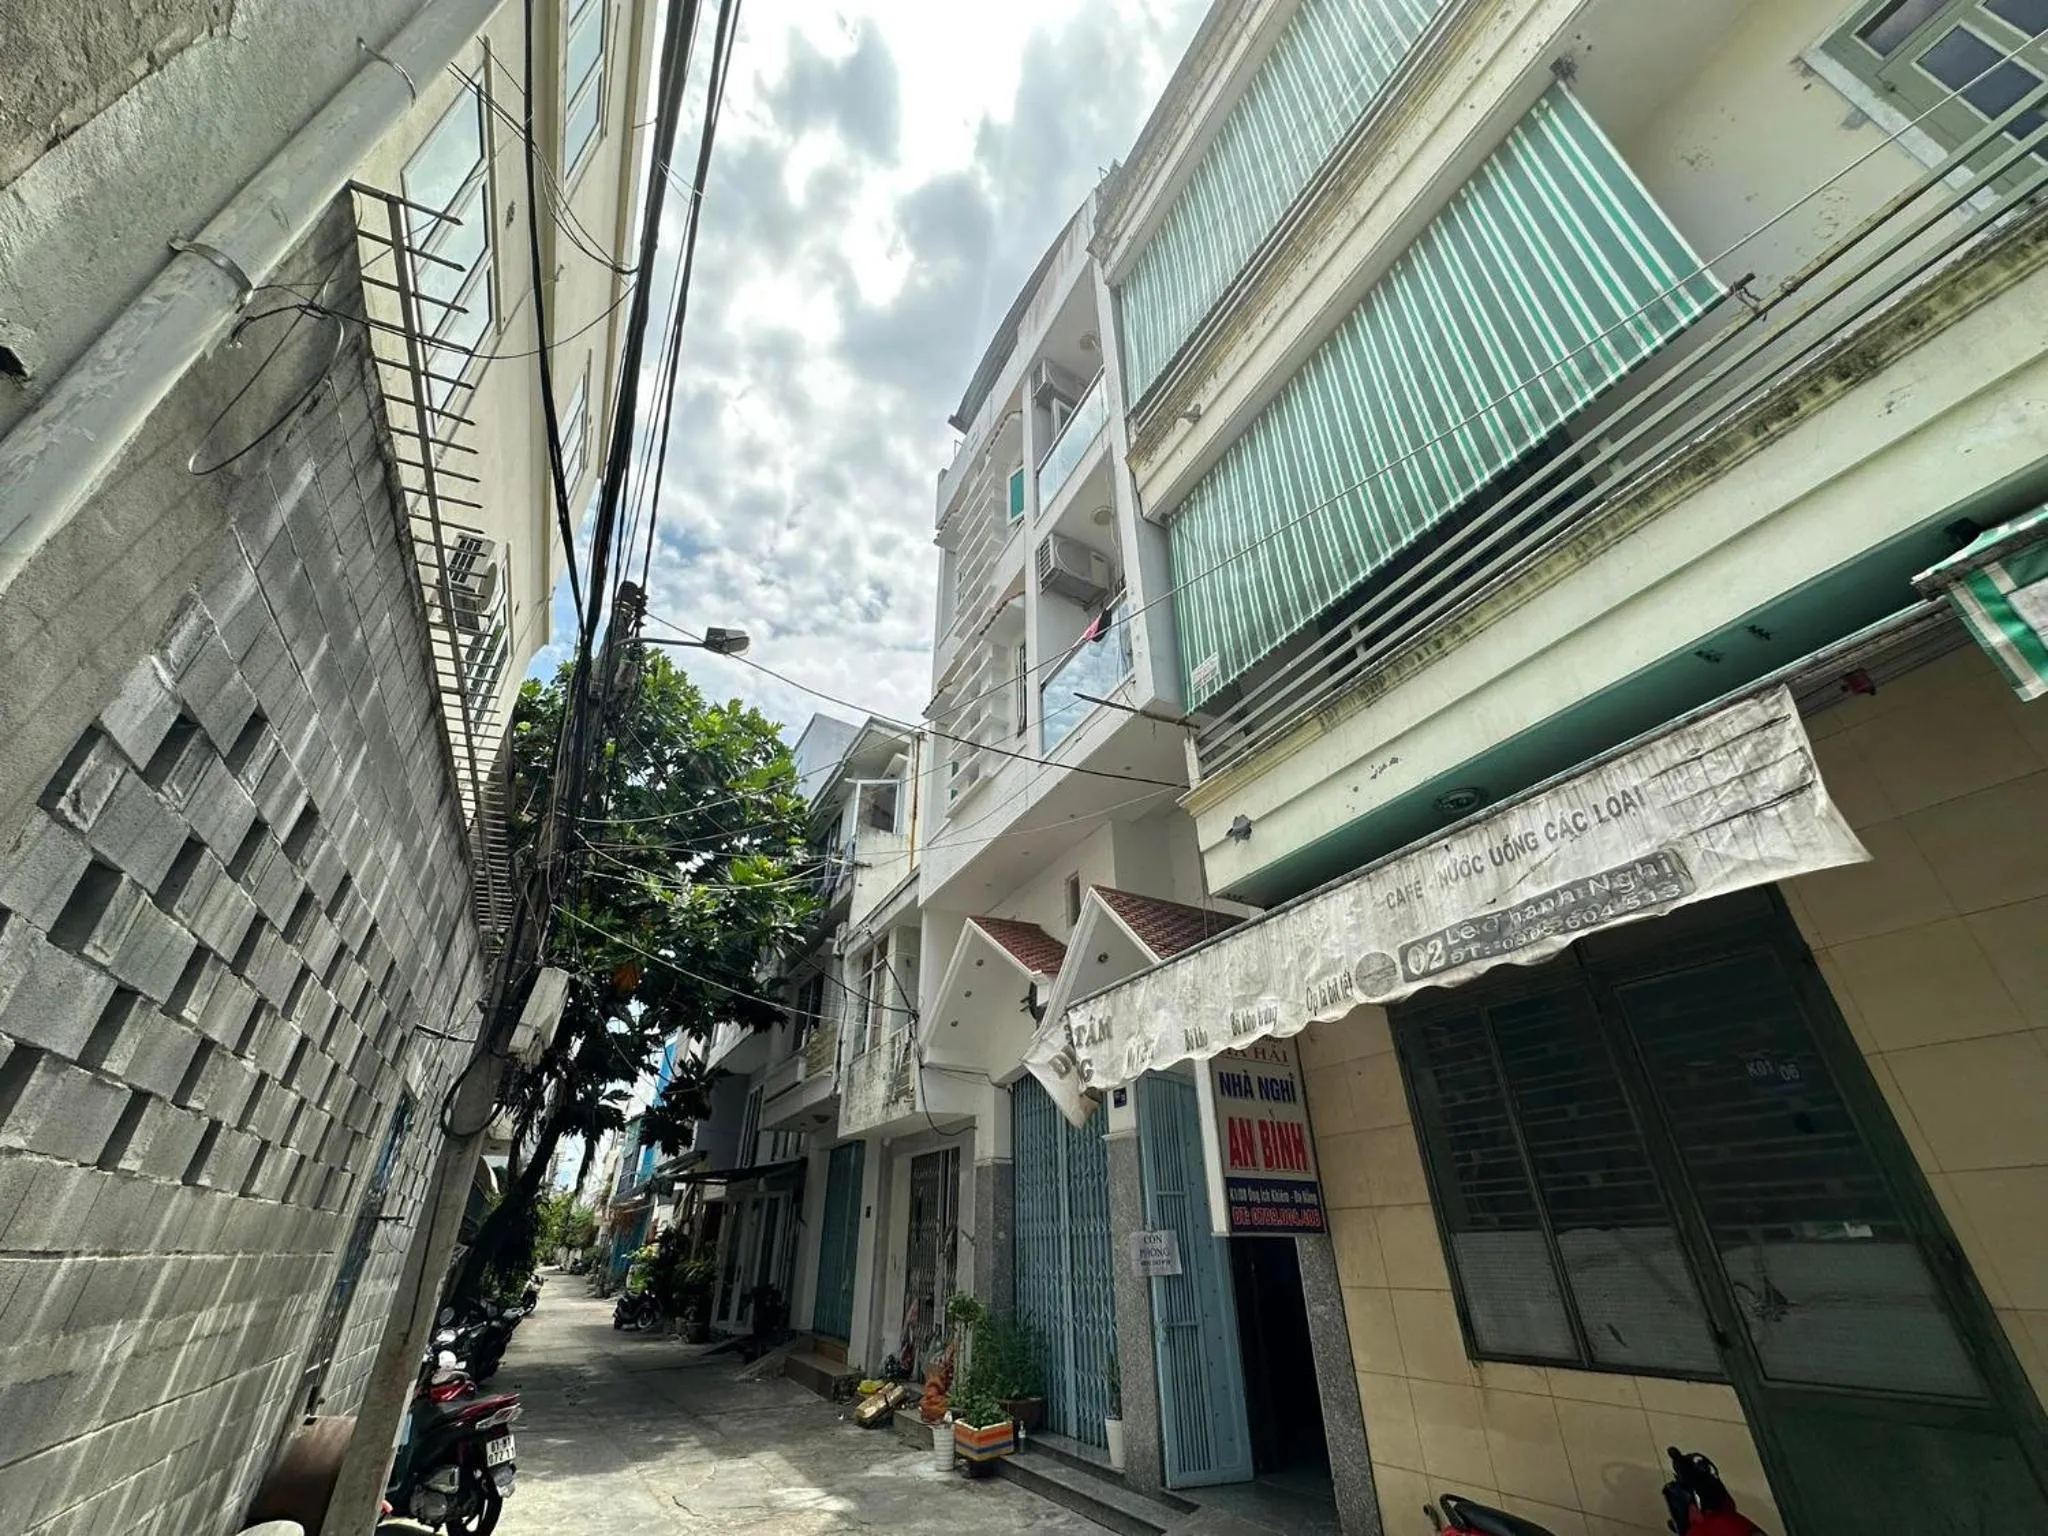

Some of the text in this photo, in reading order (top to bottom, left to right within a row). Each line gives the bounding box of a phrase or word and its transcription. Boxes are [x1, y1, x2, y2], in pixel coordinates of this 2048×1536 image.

[1490, 830, 1539, 867] UỐNG
[1543, 806, 1588, 843] CÁC
[1592, 786, 1647, 824] LOẠI
[1407, 939, 1446, 976] 02
[1219, 1069, 1297, 1102] NHÀ NGHỈ
[1228, 1109, 1307, 1170] AN BÌNH
